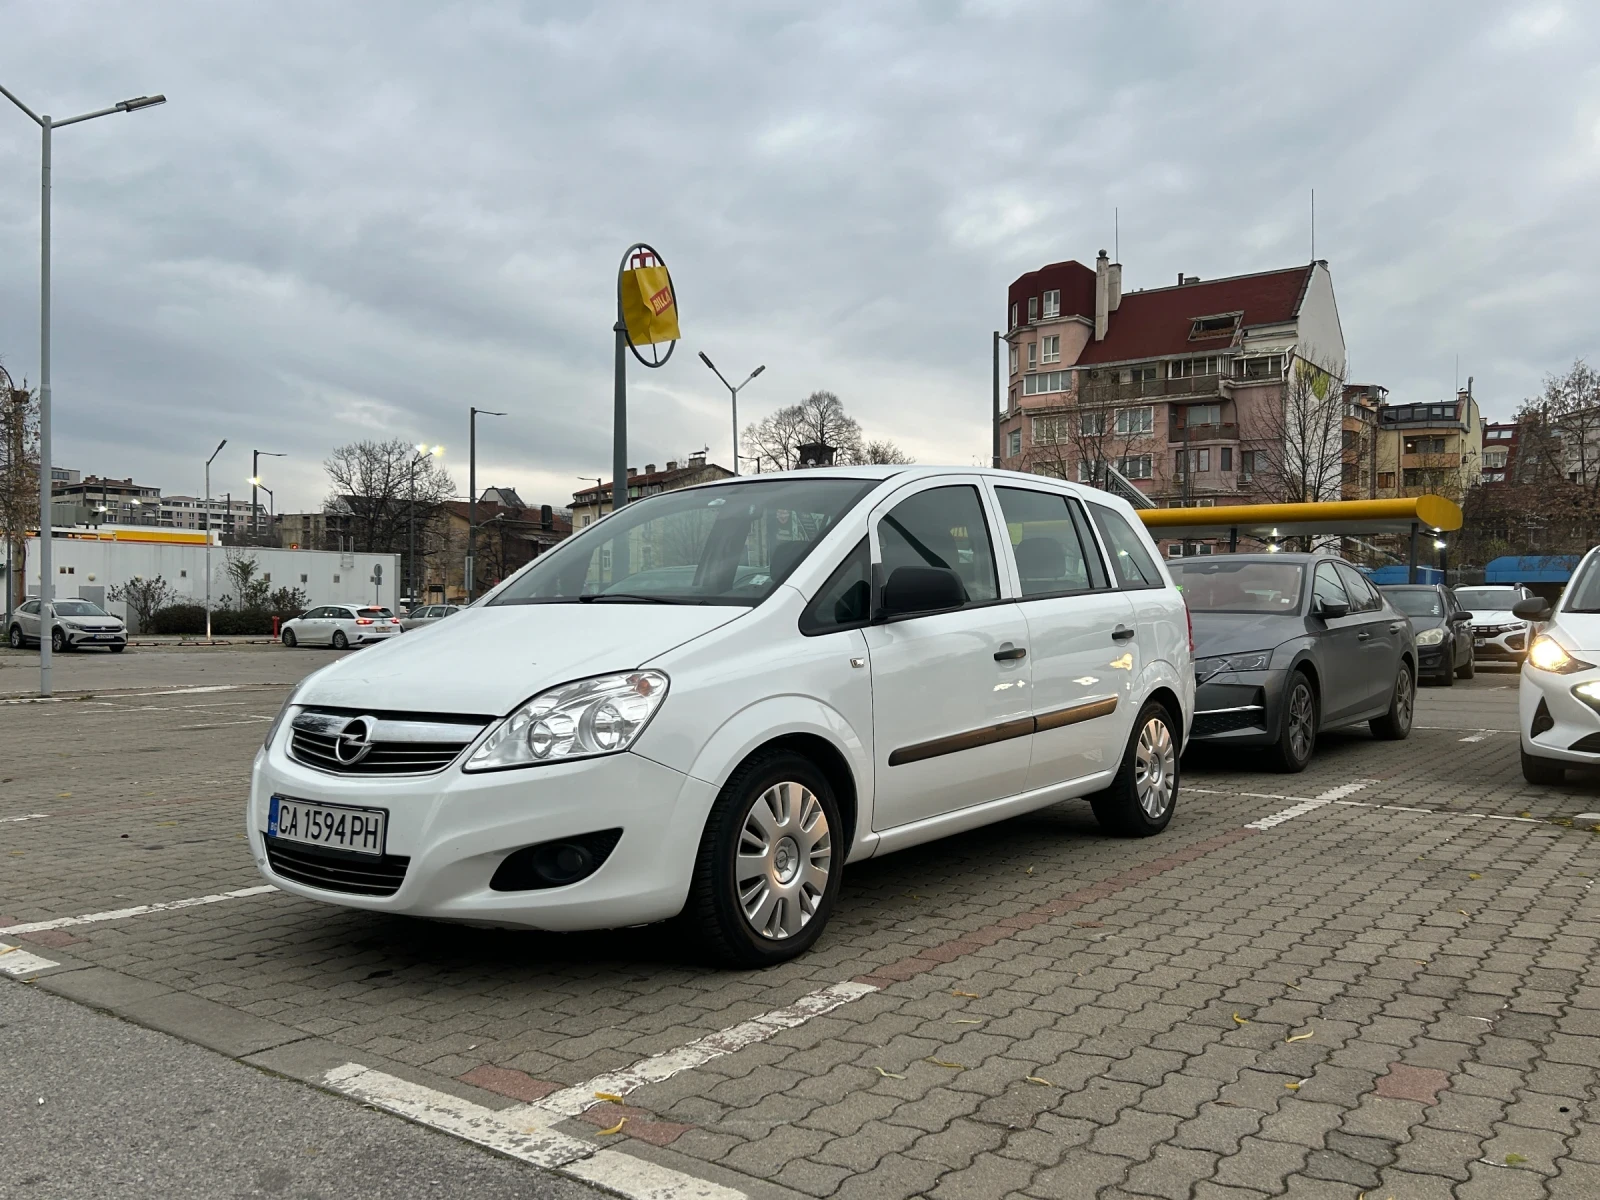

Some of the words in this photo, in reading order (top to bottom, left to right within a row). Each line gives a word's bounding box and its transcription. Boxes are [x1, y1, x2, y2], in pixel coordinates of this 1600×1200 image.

[652, 291, 672, 313] BILLA
[279, 805, 298, 836] CA
[305, 809, 347, 844] 1594
[349, 815, 379, 849] PH
